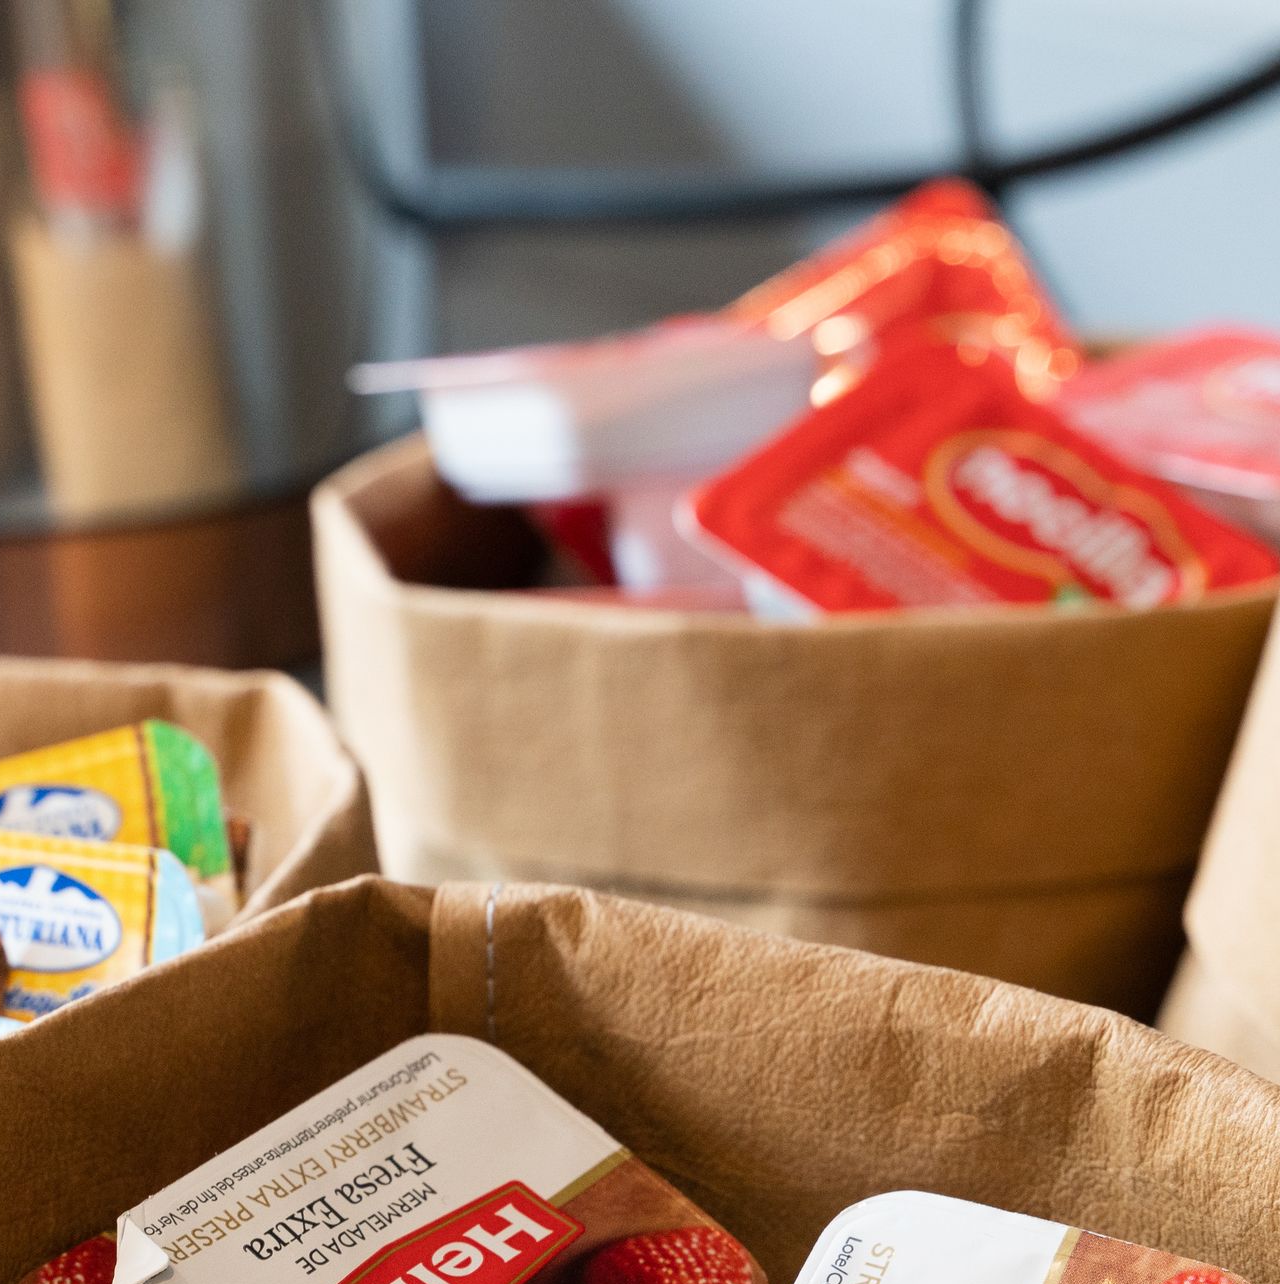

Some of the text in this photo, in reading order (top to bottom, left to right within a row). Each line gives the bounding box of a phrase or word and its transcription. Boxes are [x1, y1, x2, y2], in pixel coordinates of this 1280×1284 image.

[262, 1097, 359, 1165] preferentemente
[327, 1064, 468, 1166] STRAWBERRY
[195, 1187, 218, 1205] fin
[211, 1174, 237, 1197] del
[230, 1154, 268, 1184] antes
[241, 1155, 324, 1212] EXTRA
[156, 1211, 182, 1229] Ver
[241, 1141, 437, 1265] Fresa Extra
[294, 1180, 437, 1276] MERMELADA DE
